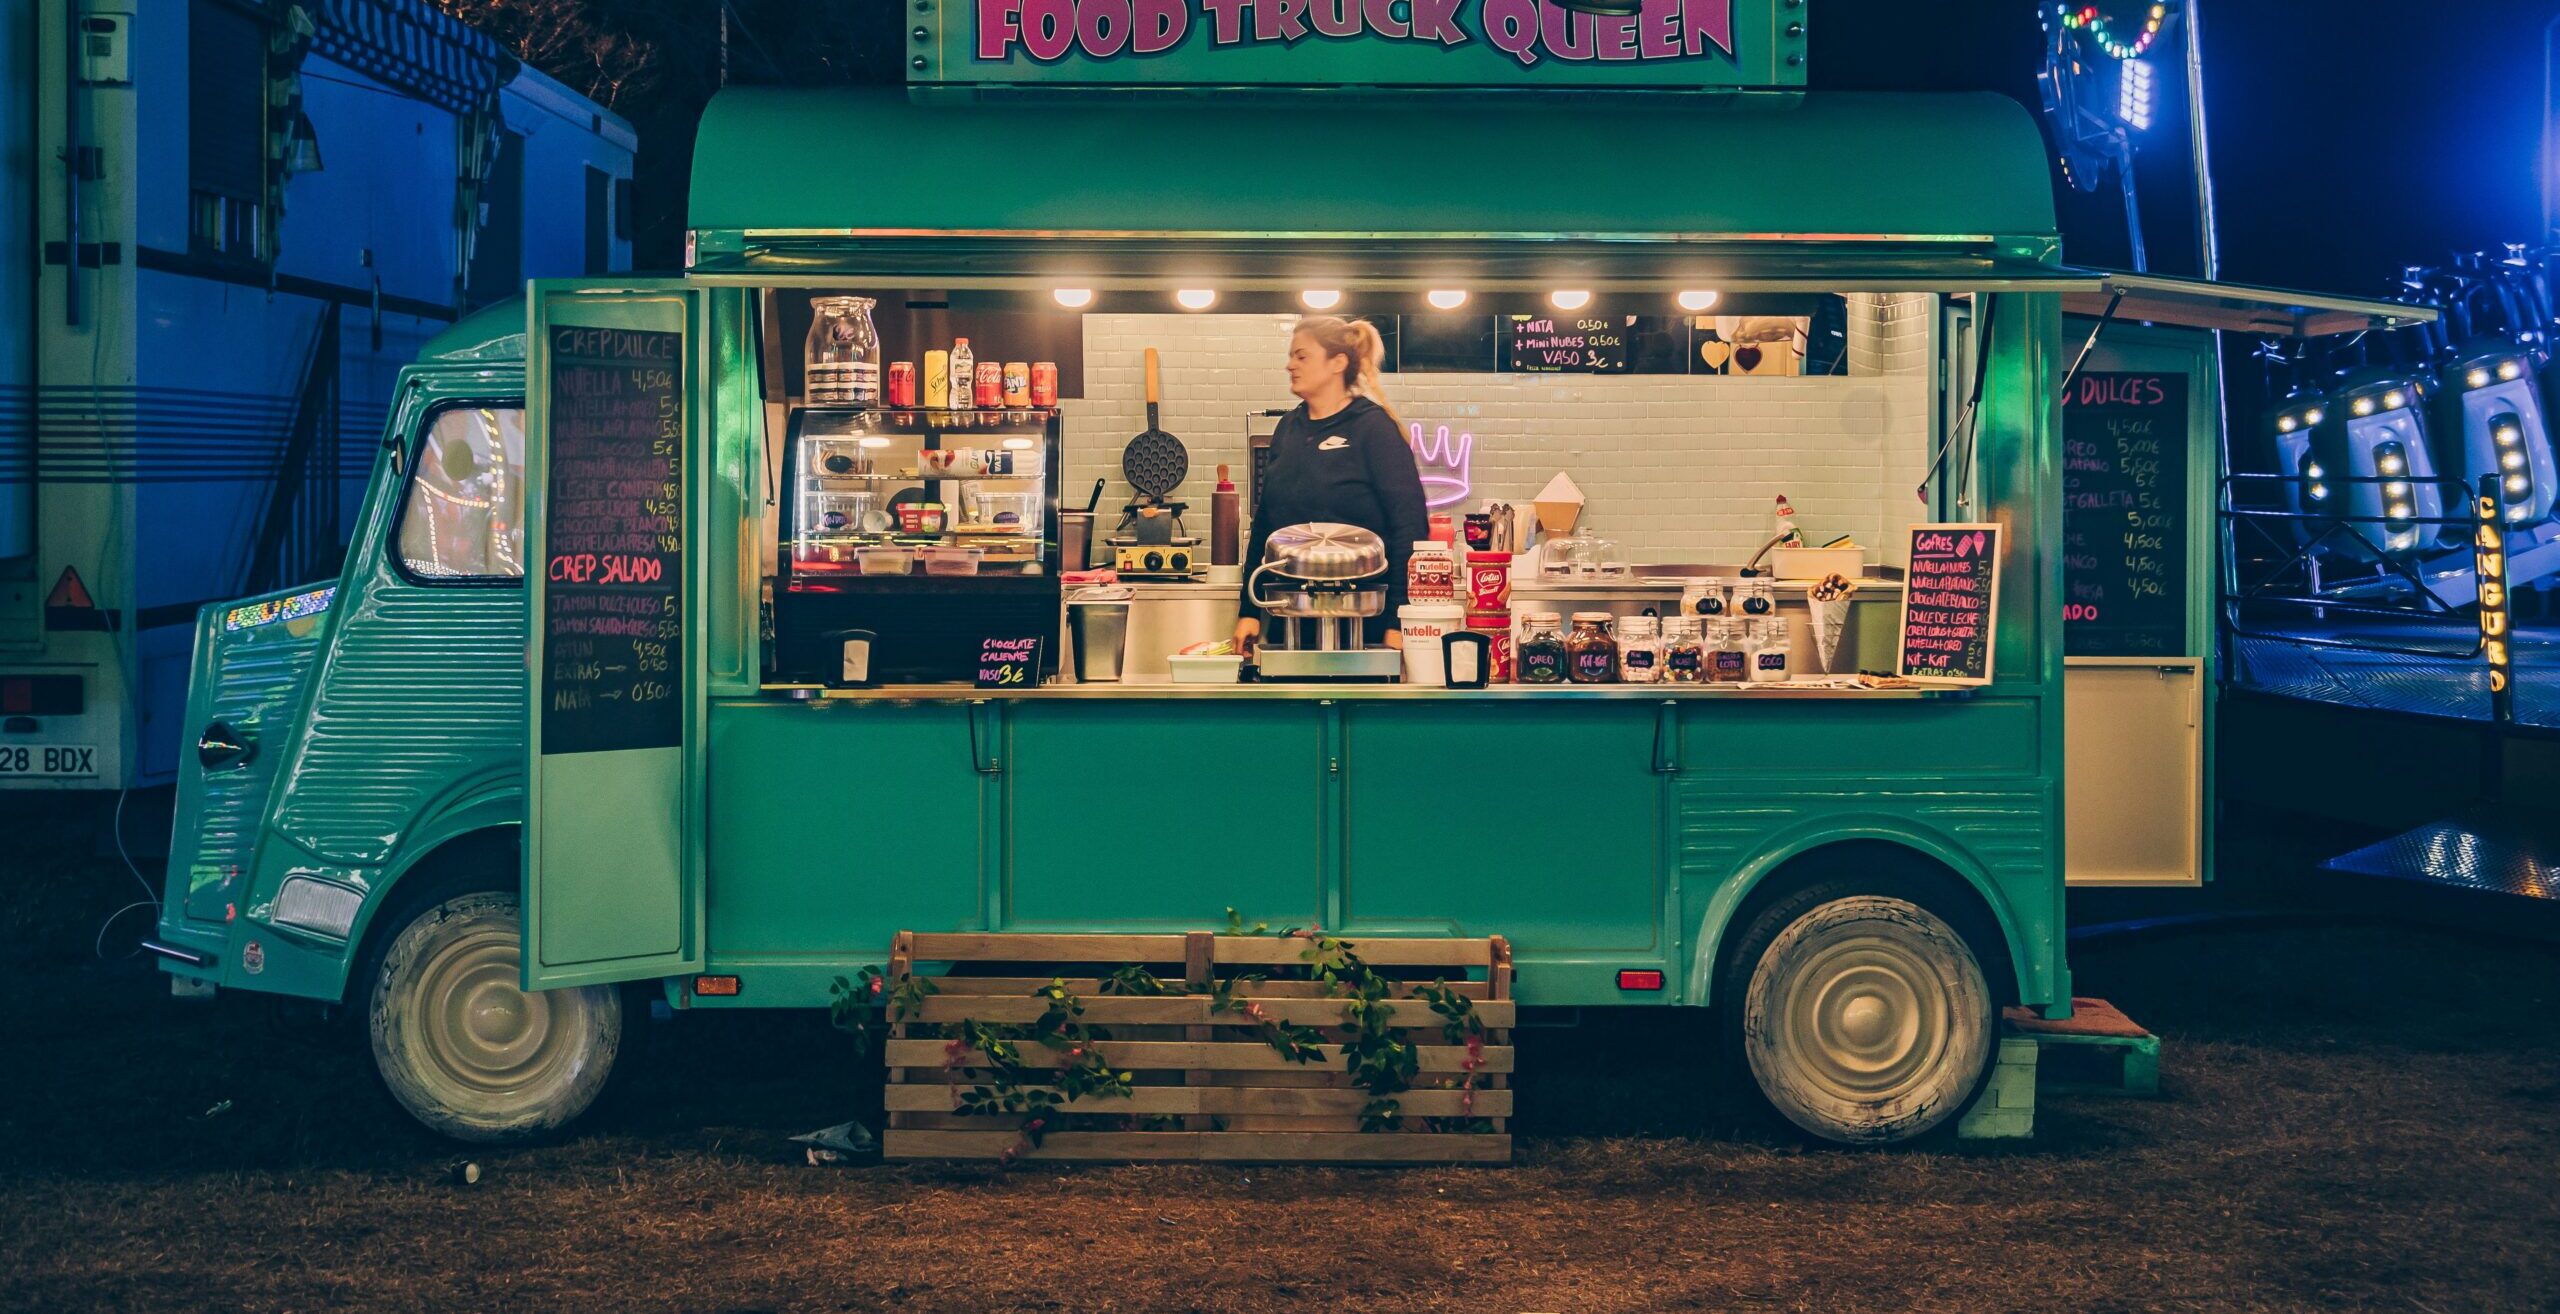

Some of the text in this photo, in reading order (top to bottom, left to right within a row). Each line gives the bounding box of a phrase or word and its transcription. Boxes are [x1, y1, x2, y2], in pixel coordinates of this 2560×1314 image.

[978, 0, 1733, 65] FOOD TRUCK QUEEN
[1526, 319, 1554, 334] NATA
[1550, 336, 1585, 349] NUBES
[1542, 350, 1580, 366] VASO
[2080, 376, 2164, 406] DULCES
[549, 552, 663, 585] CREP SALADO
[1419, 560, 1450, 571] nutella
[552, 594, 596, 613] JAMON
[551, 617, 587, 636] JAMON
[1403, 625, 1441, 637] nutella
[982, 638, 1037, 650] CHOCOLATE
[980, 651, 1030, 663] CALIENTE
[1529, 655, 1554, 666] OREO
[1759, 655, 1783, 667] COCO
[0, 746, 93, 773] 28 BDX
